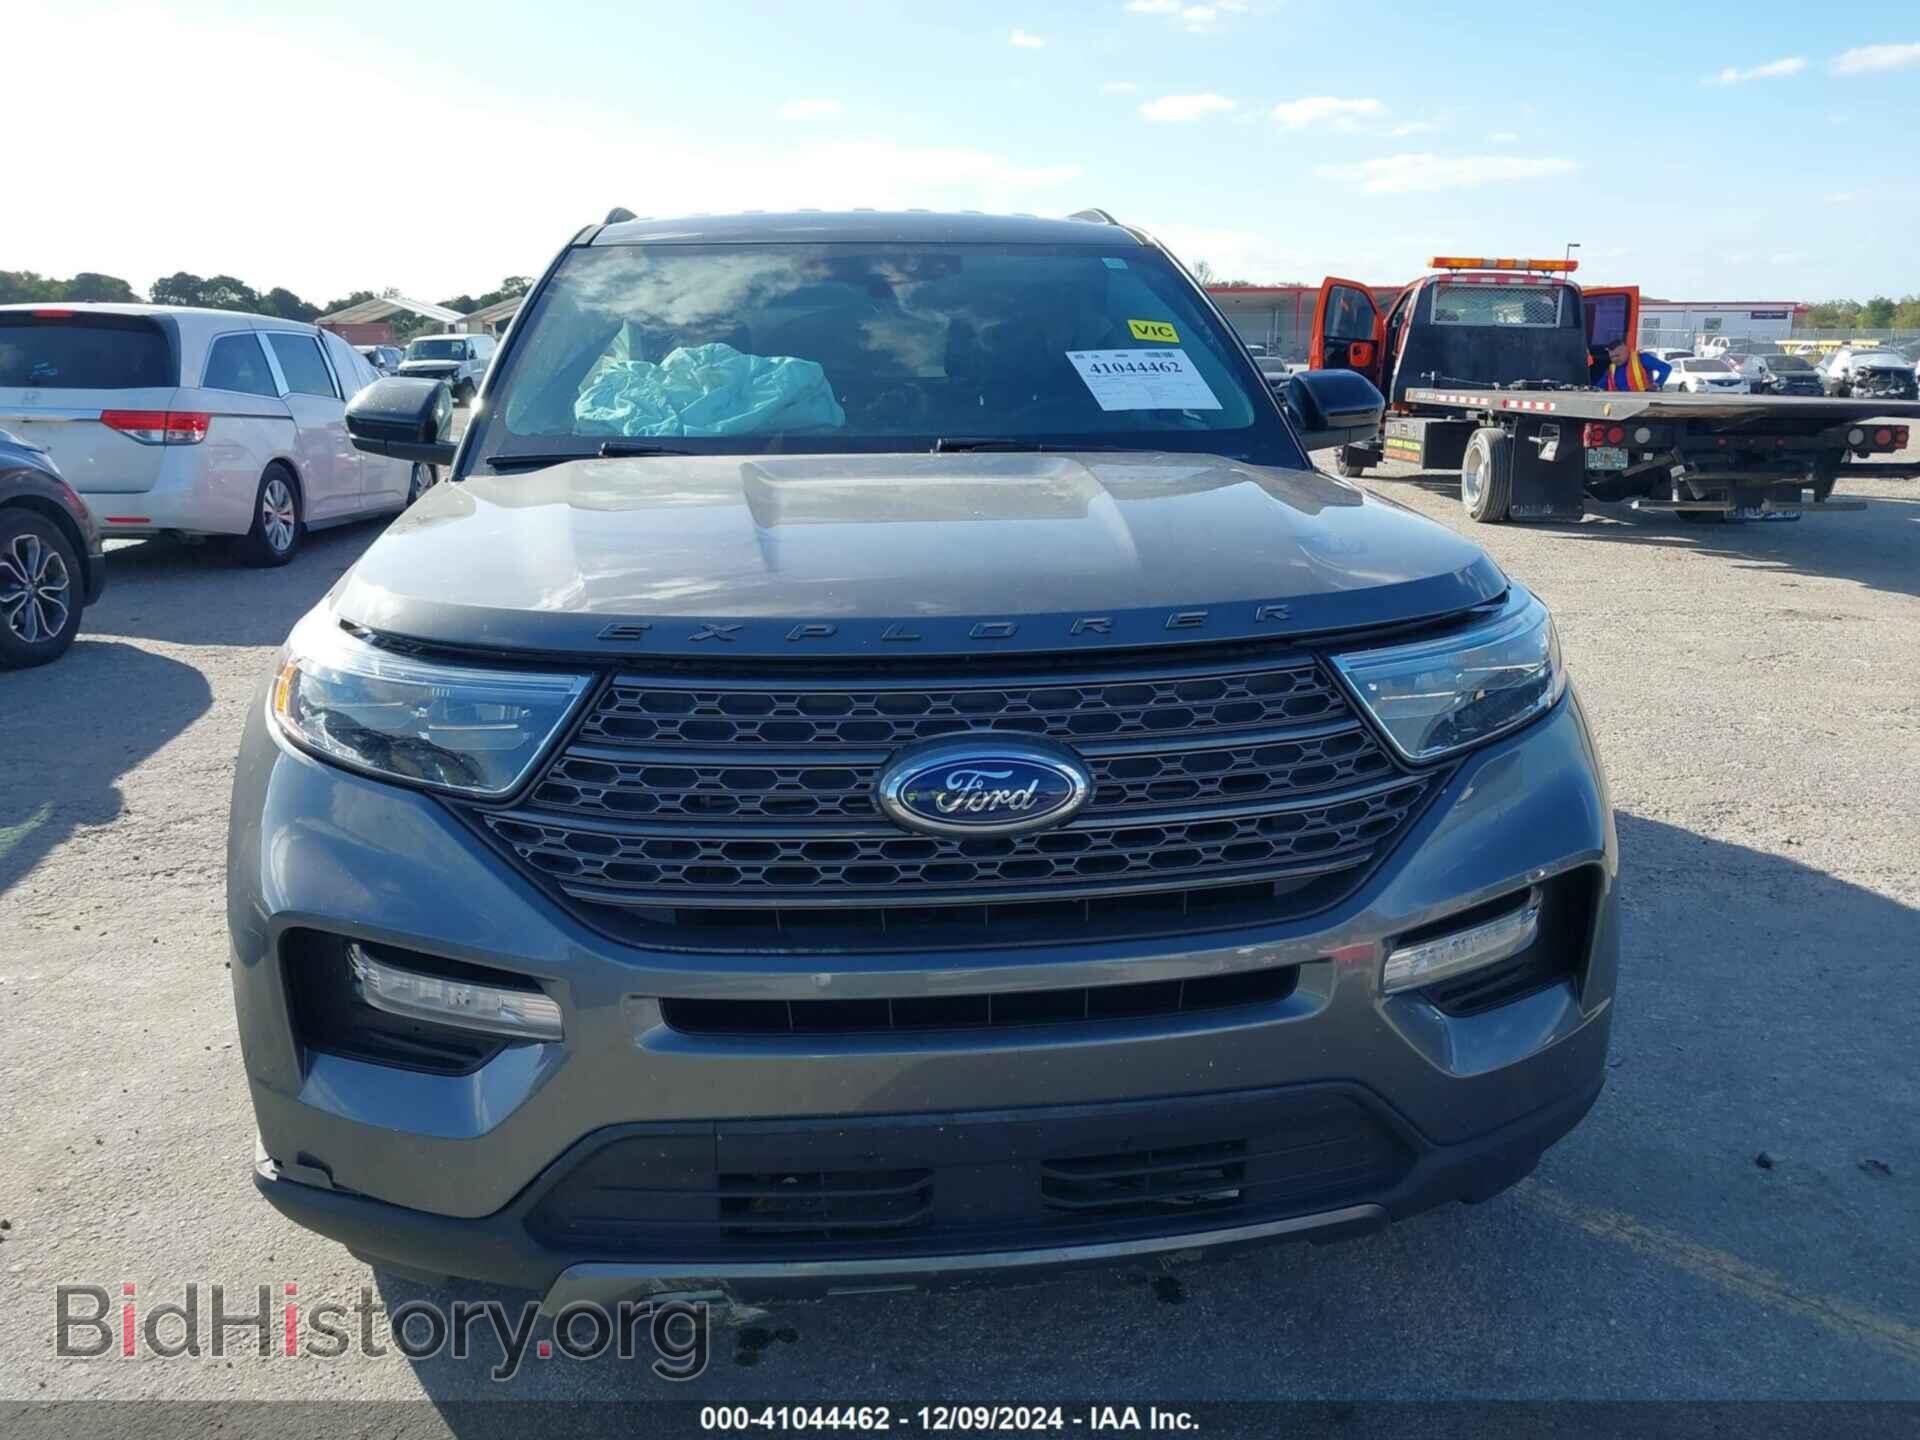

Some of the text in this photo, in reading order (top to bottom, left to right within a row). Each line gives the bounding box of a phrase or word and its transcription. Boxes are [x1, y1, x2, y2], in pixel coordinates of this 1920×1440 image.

[1134, 325, 1173, 337] VIC
[1091, 361, 1183, 373] 41044462
[597, 603, 1290, 641] EXPLORER
[936, 769, 1039, 813] Ford
